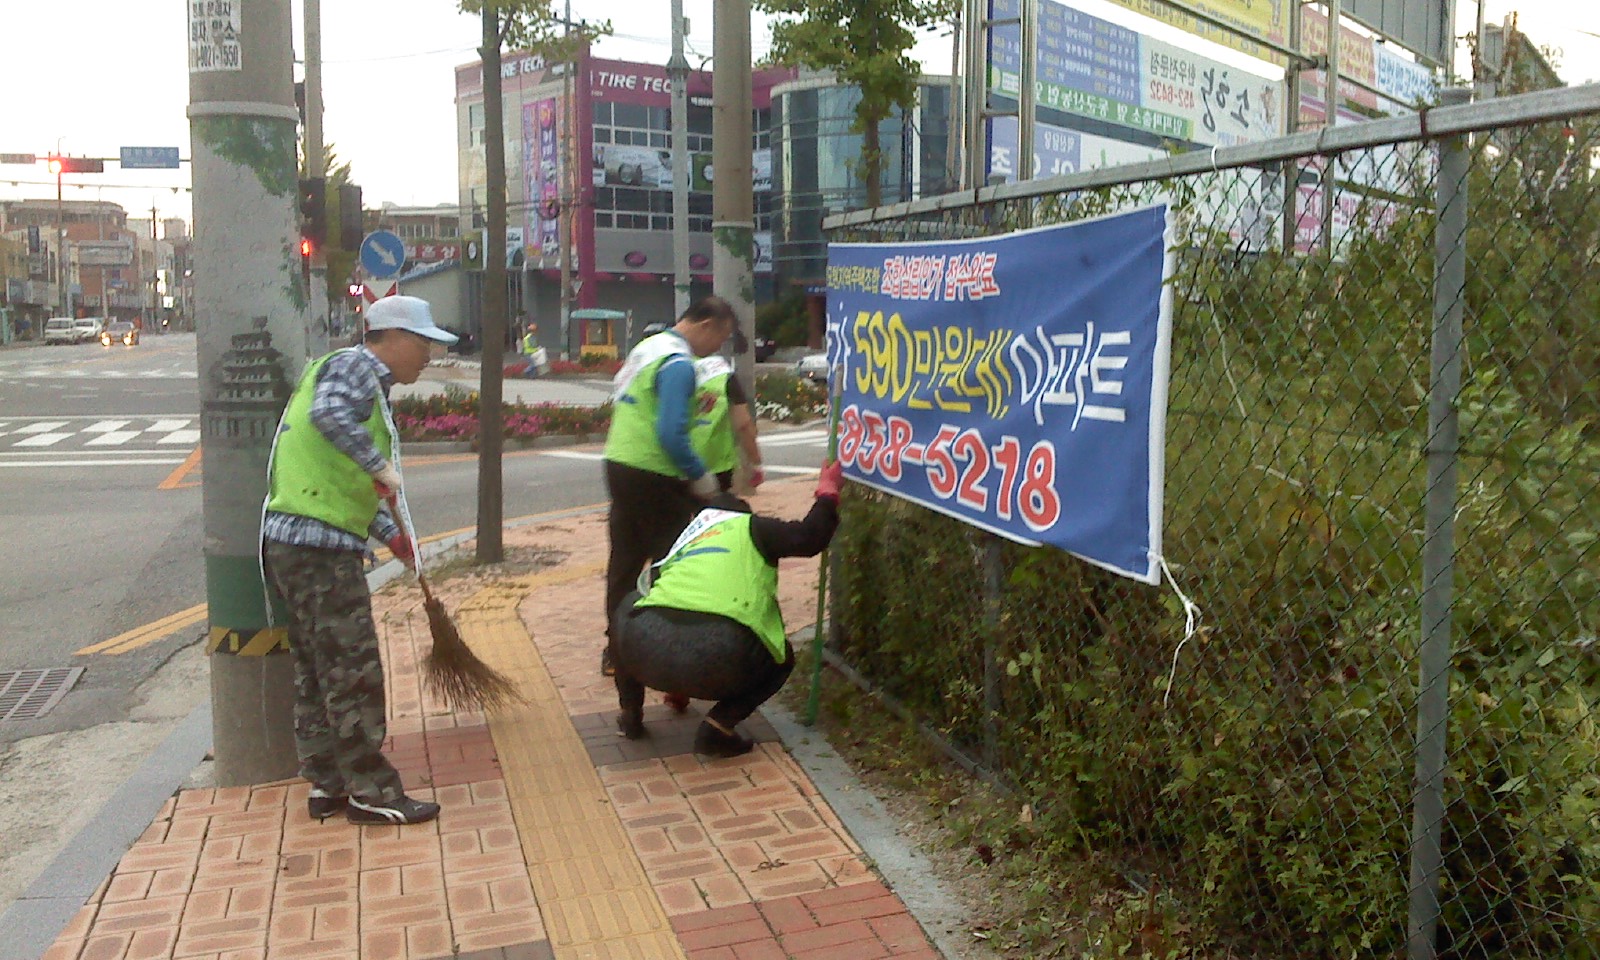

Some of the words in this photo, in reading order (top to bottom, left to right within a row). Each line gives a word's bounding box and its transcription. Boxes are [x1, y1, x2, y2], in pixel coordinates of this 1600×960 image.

[519, 54, 545, 73] TECH
[598, 71, 637, 91] TIRE
[643, 76, 672, 94] TEC
[1010, 320, 1131, 432] 아파트
